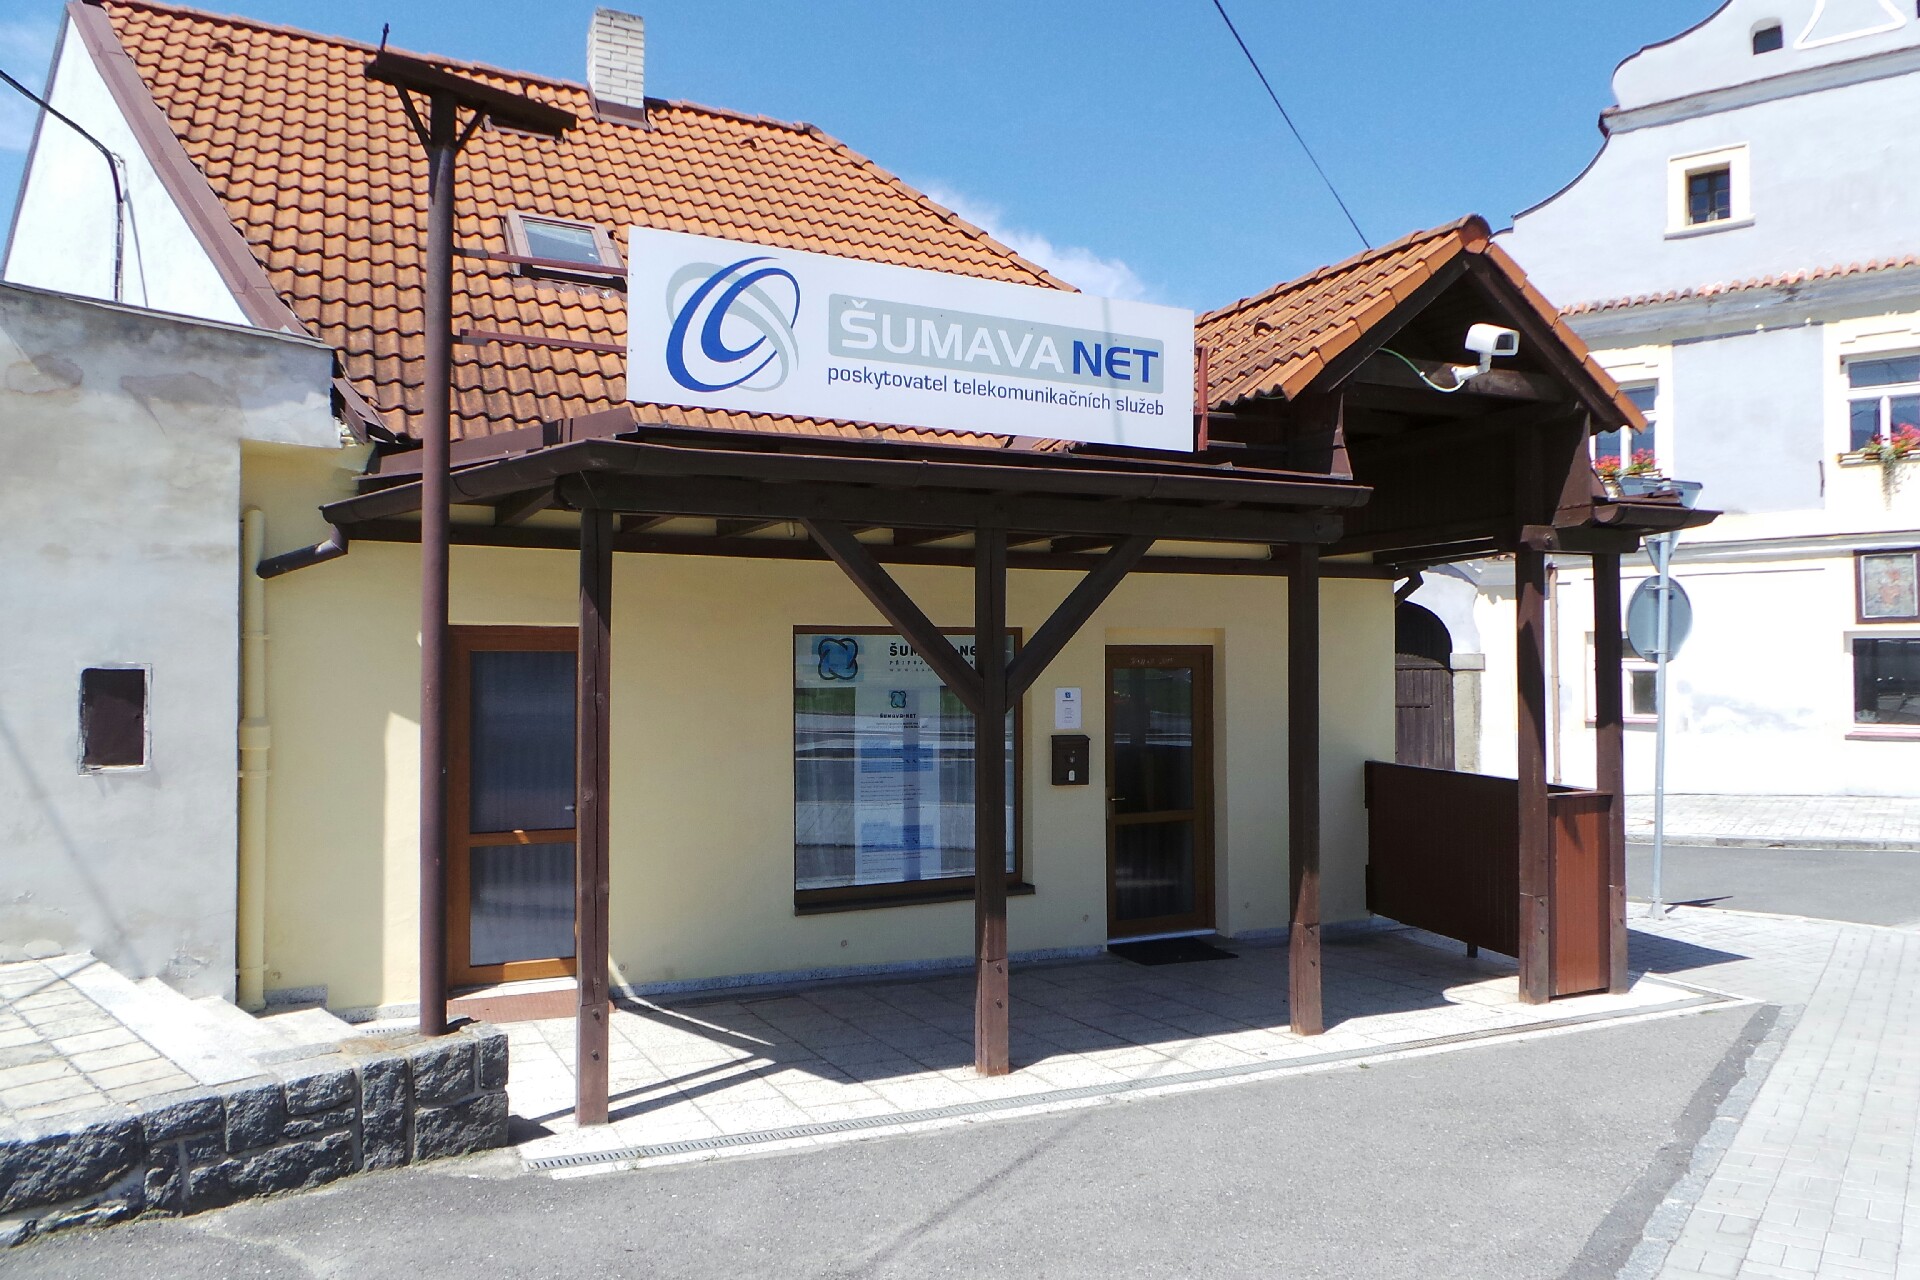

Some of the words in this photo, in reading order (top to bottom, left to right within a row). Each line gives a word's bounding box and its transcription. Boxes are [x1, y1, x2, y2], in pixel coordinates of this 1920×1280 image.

[840, 299, 1065, 374] ŠUMAVA
[1073, 340, 1159, 383] NET
[828, 366, 947, 393] poskytovatel
[953, 378, 1110, 410] telekomunikačních
[1116, 396, 1164, 416] služeb
